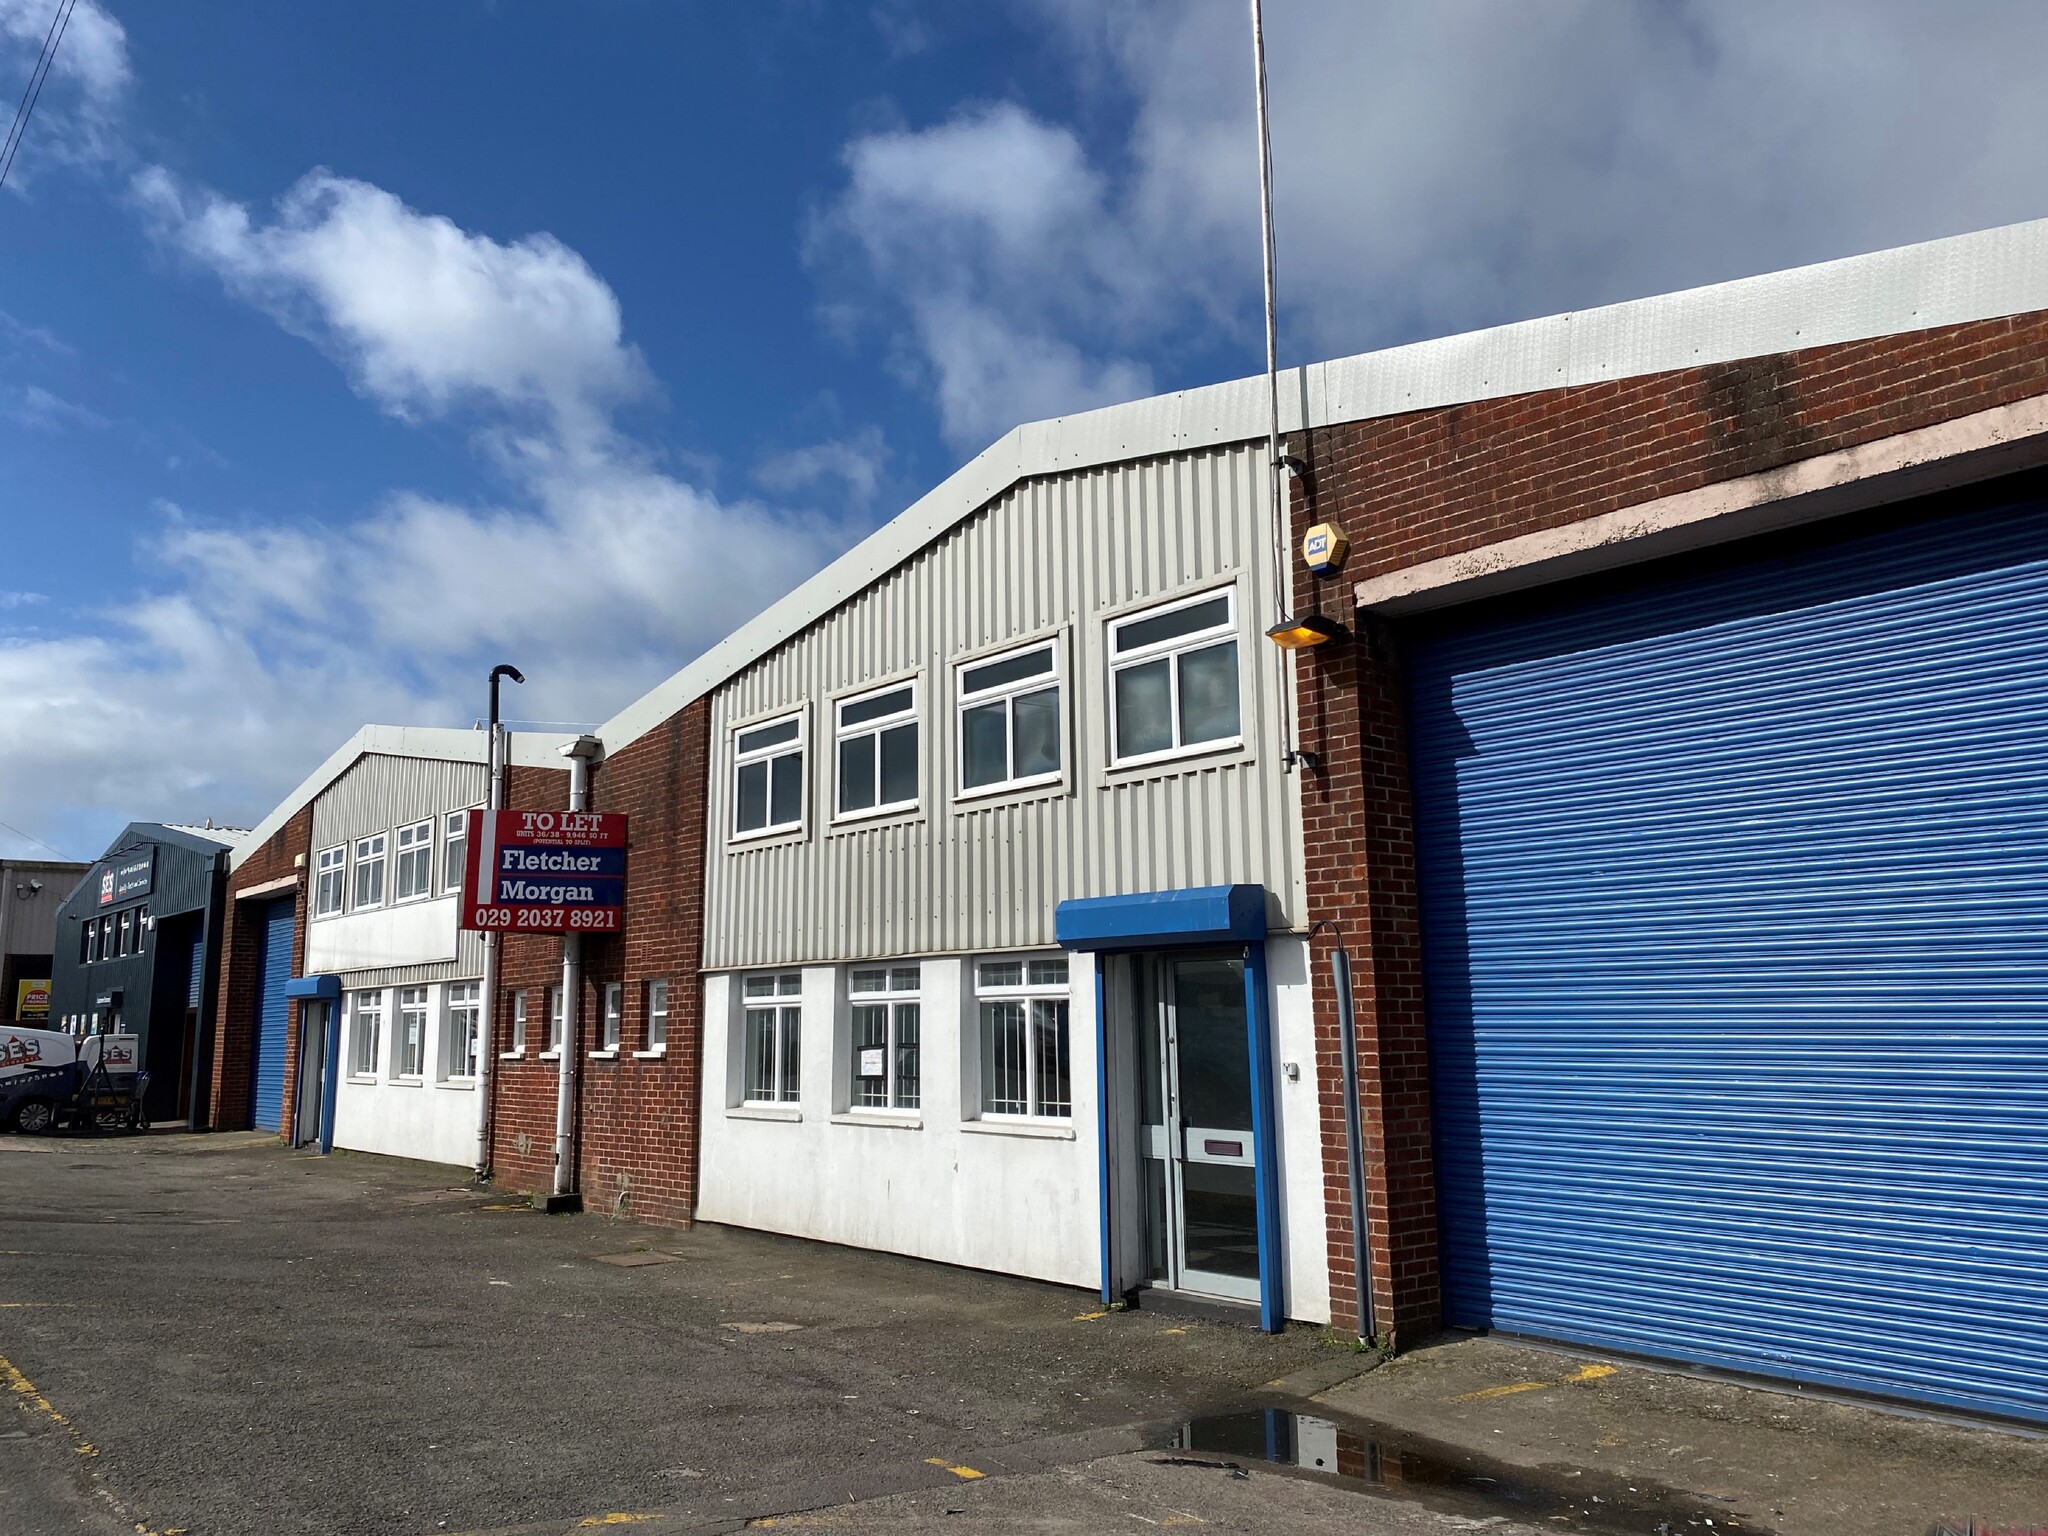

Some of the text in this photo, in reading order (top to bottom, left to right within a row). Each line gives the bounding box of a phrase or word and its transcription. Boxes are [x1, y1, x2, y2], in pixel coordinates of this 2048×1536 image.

[1308, 538, 1326, 552] ADT
[522, 812, 602, 831] TO LET
[502, 850, 601, 871] Fletcher
[500, 880, 594, 904] Morgan
[475, 908, 615, 928] 029 2037 8921
